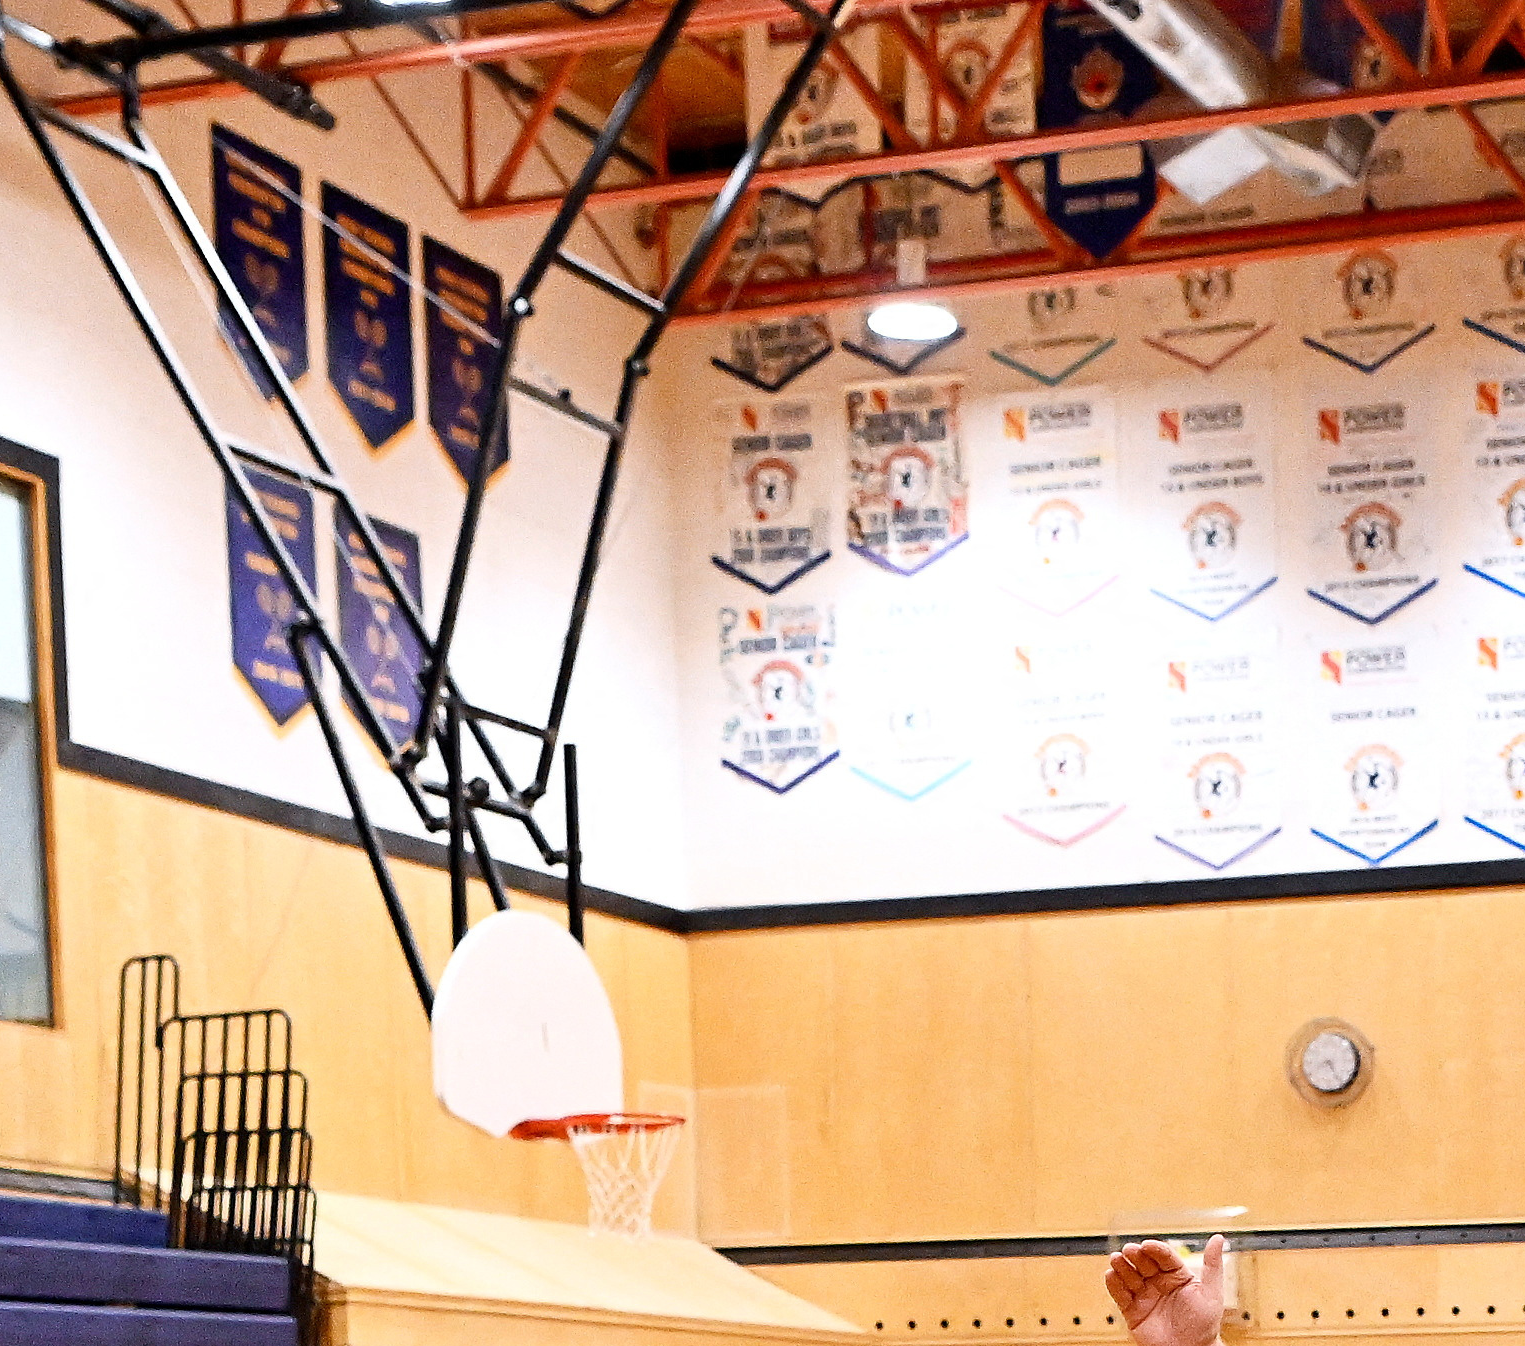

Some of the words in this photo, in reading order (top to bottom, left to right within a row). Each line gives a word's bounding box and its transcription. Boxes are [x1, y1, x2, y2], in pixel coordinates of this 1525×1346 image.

[1029, 402, 1091, 420] POWER
[1183, 402, 1243, 420] POWER
[1344, 402, 1405, 421] POWER
[1169, 462, 1211, 475] SENIOR
[1328, 463, 1371, 476] SENIOR
[1346, 647, 1406, 663] POWER
[1331, 709, 1373, 722] SENIOR
[1377, 706, 1416, 719] CAGER
